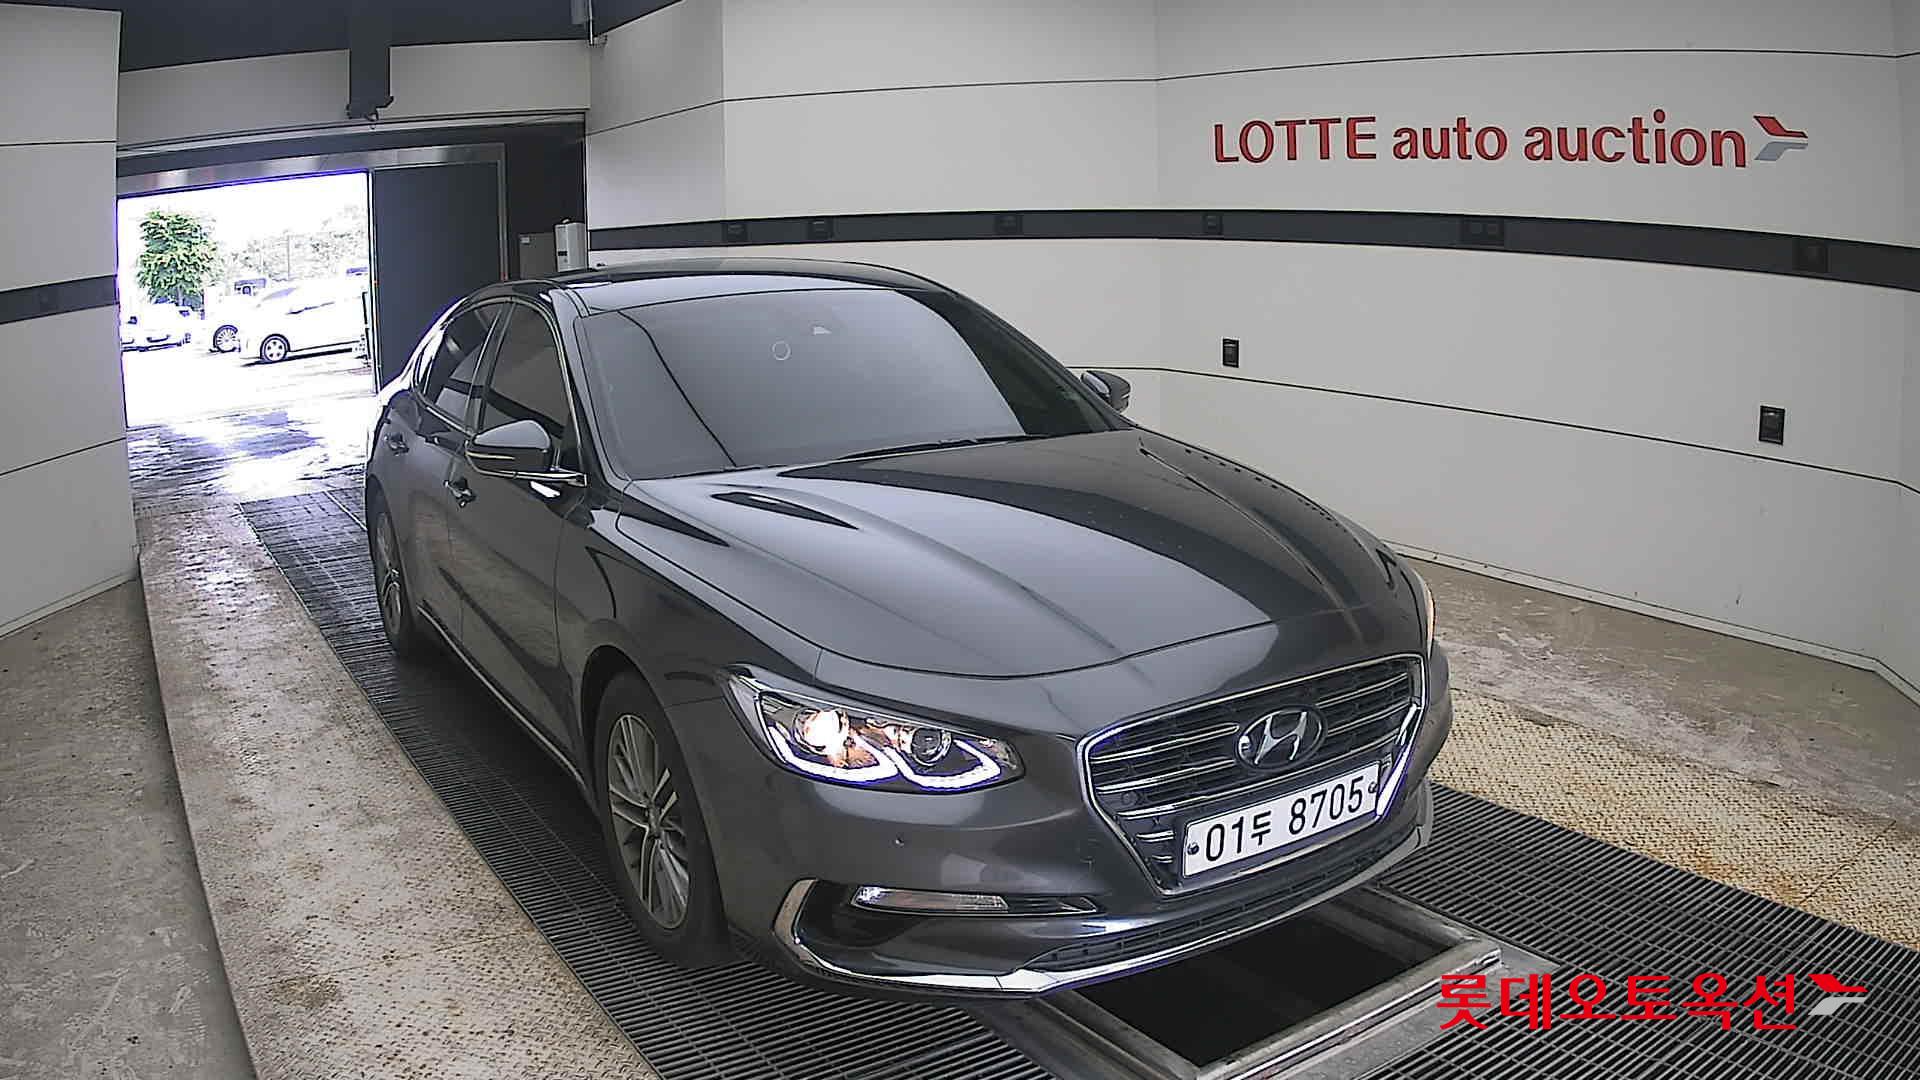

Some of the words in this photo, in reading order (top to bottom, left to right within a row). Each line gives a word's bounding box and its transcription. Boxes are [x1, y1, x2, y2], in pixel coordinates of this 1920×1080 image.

[1214, 117, 1377, 163] LOTTE
[1392, 117, 1507, 161] auto
[1523, 109, 1747, 168] auction
[1205, 810, 1272, 861] 01두
[1288, 776, 1364, 835] 8705
